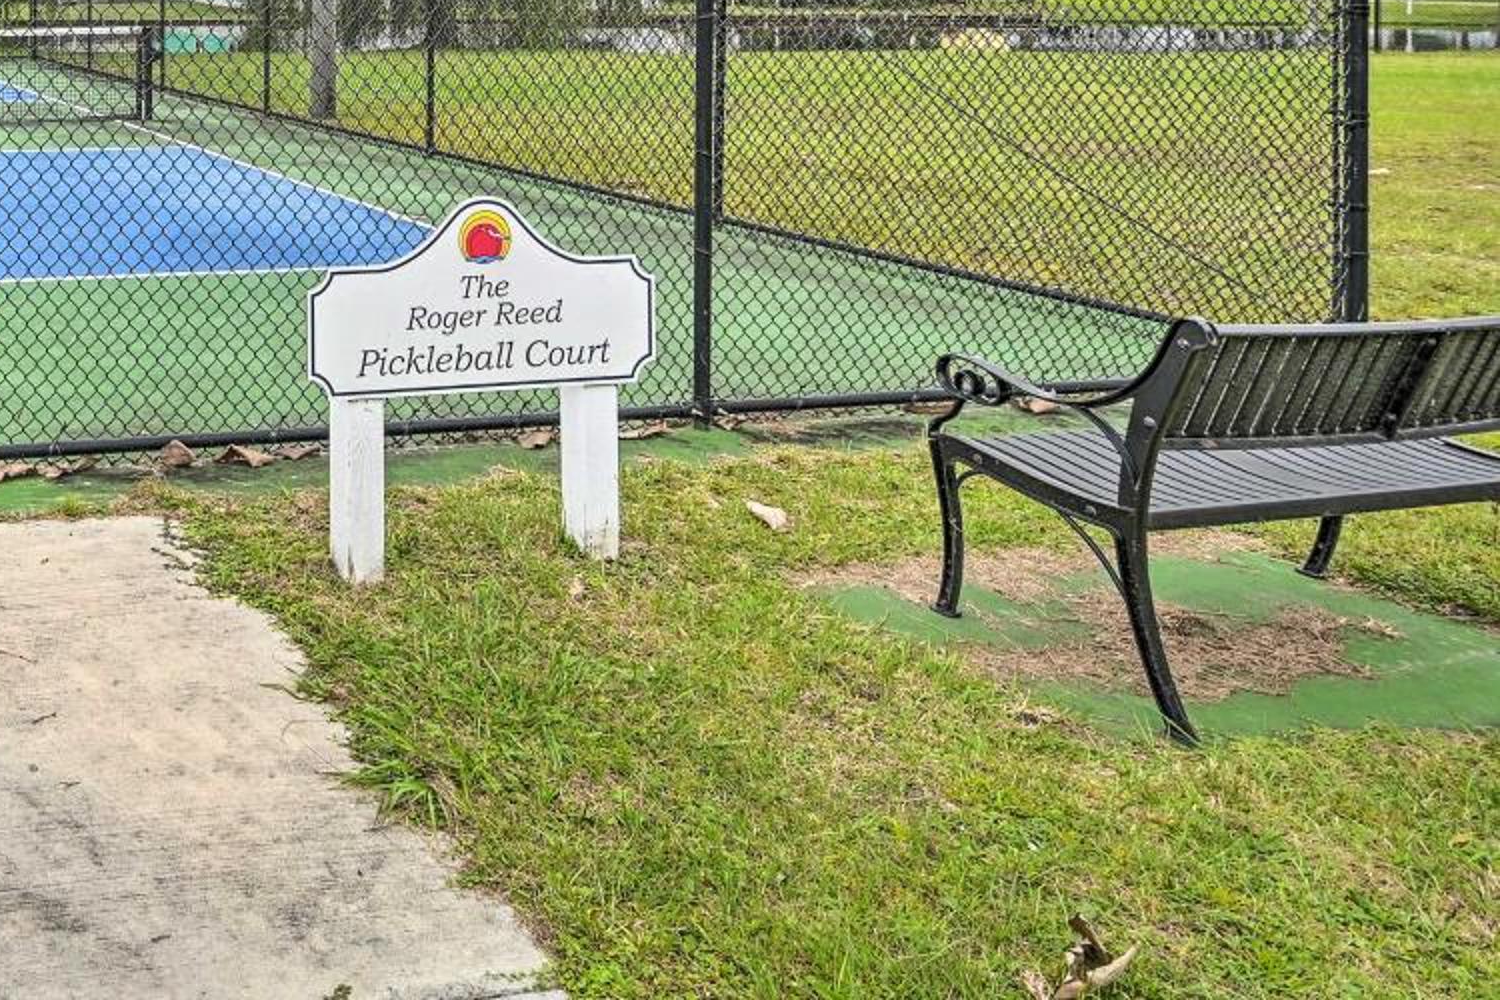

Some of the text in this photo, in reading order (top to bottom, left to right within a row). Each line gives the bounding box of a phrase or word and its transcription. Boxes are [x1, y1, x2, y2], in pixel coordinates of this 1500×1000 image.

[461, 274, 509, 299] The
[406, 299, 563, 336] Roger Reed
[356, 338, 611, 378] Pickleball Court
